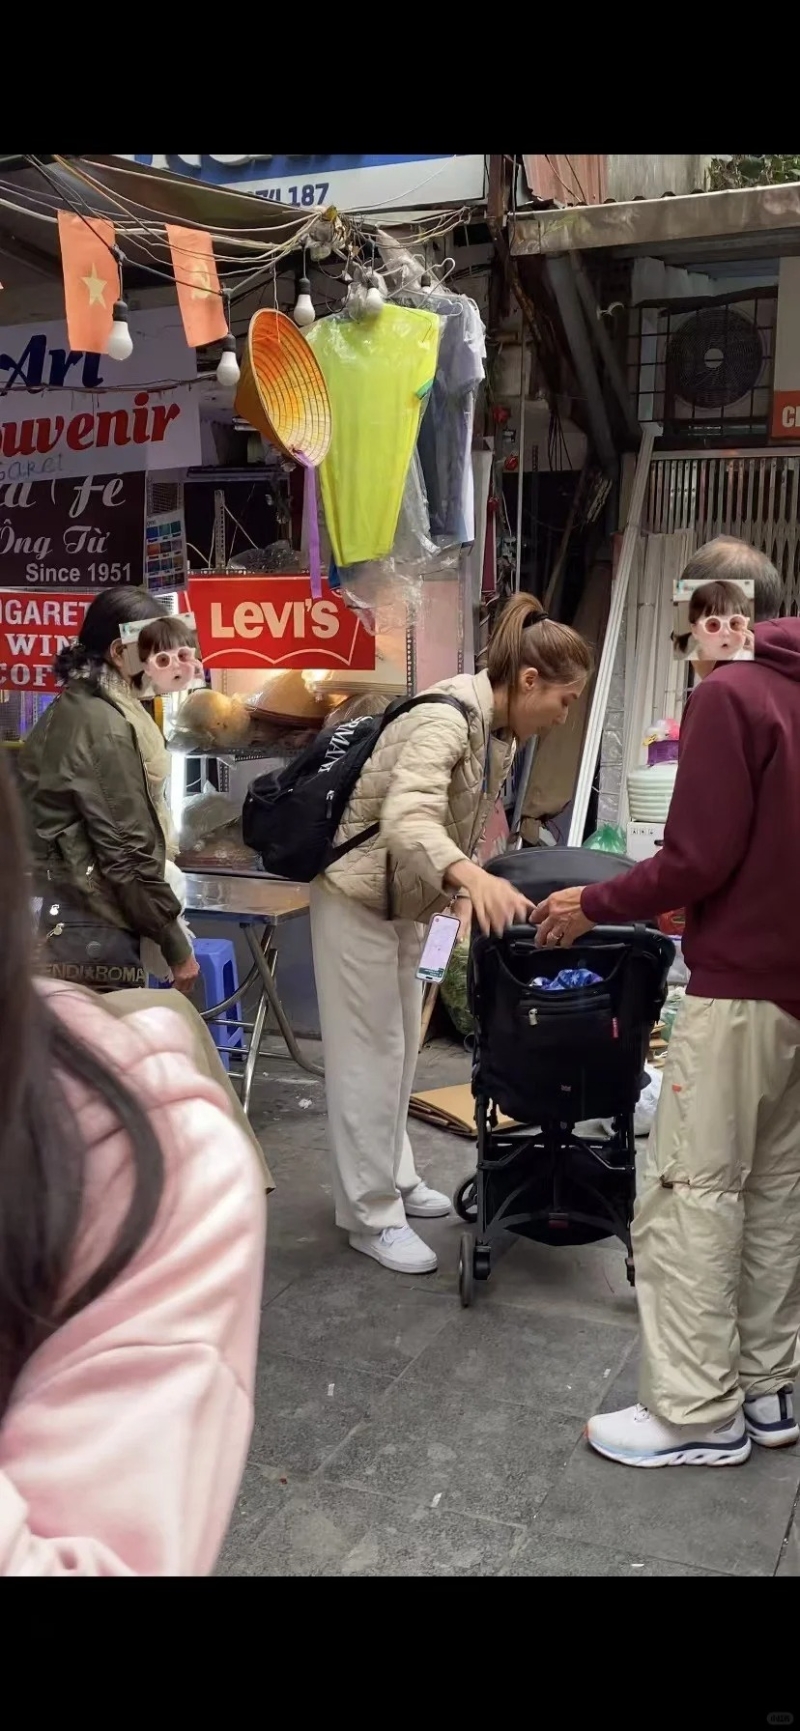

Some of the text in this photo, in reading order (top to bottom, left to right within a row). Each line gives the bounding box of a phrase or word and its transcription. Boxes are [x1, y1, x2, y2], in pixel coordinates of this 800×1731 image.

[288, 183, 330, 207] 187
[0, 392, 181, 457] uvenir
[26, 562, 131, 582] Since 1951
